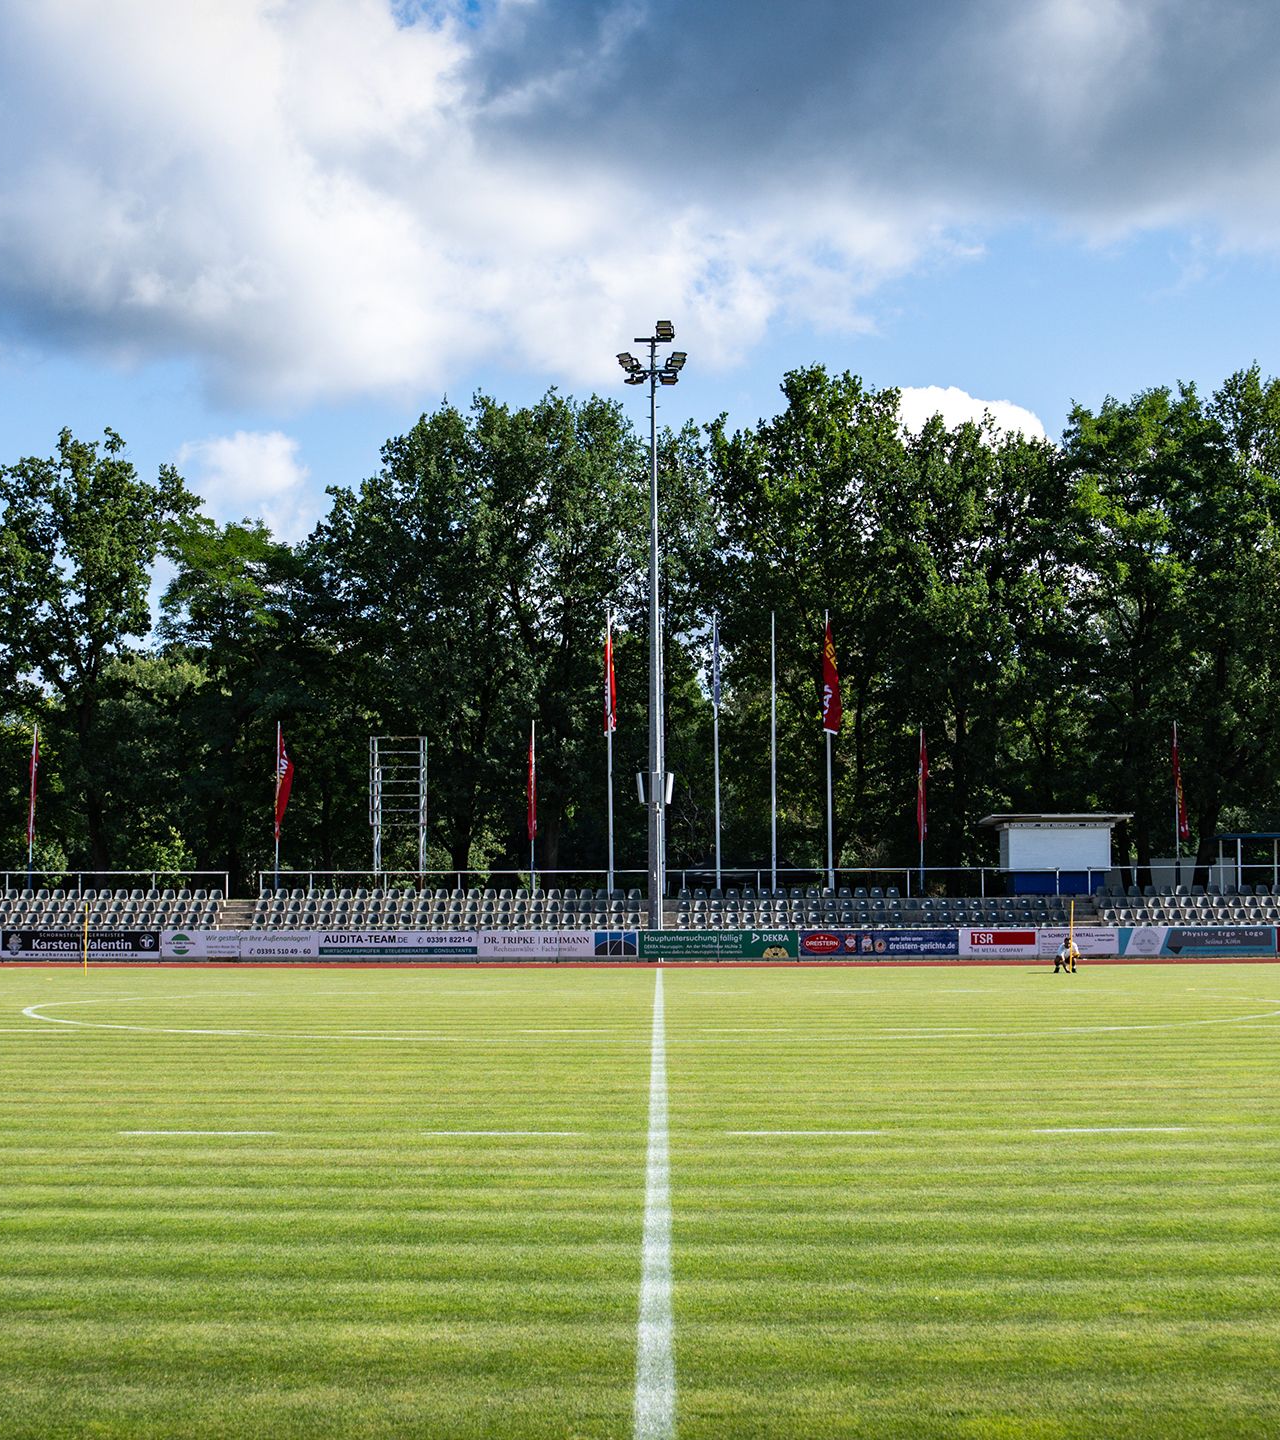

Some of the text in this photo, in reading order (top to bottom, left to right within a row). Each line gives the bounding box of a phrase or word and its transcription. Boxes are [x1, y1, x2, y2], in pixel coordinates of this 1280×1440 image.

[263, 934, 312, 943] Außenanlagen!
[483, 936, 500, 944] DR.
[503, 936, 536, 944] TRIPKE
[543, 936, 590, 944] REHMANN
[643, 933, 743, 943] Hauptuntersuchung fällig?
[762, 934, 789, 942] DEKRA
[972, 933, 994, 944] TSR
[31, 939, 78, 950] Karsten
[888, 942, 956, 952] dreistern-gerichte.de
